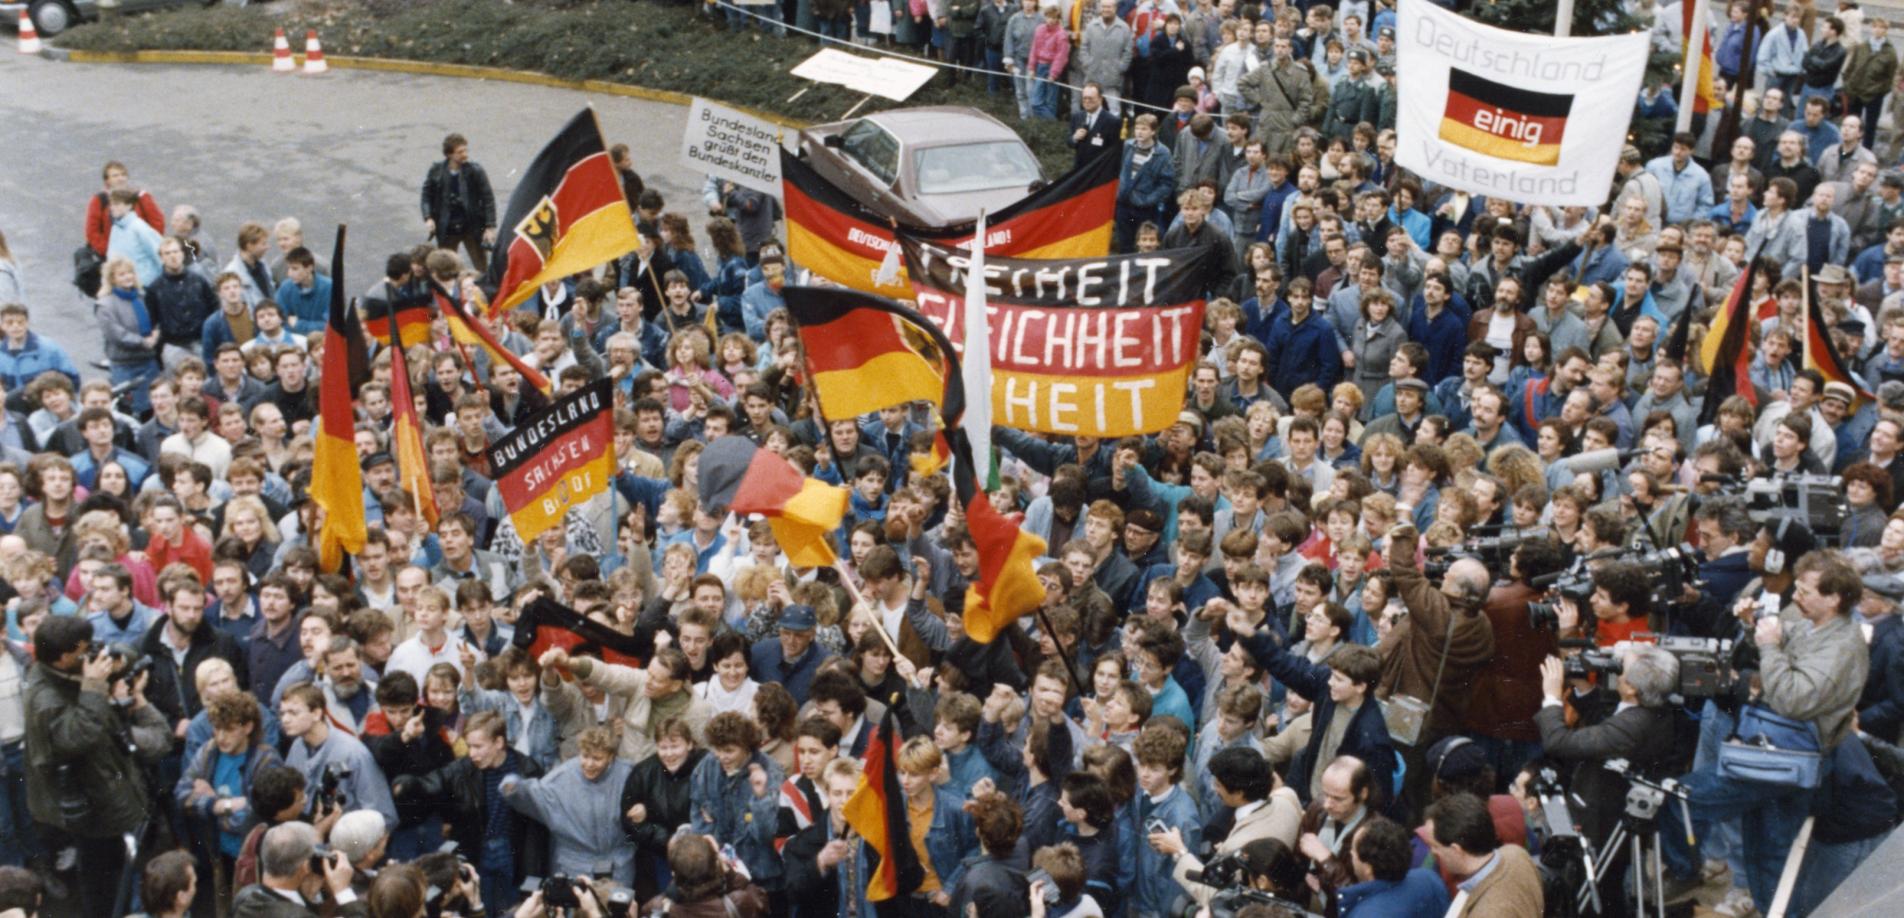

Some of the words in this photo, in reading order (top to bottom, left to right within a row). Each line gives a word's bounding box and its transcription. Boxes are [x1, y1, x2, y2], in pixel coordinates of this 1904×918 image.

[1416, 16, 1607, 82] Deutschland
[706, 125, 770, 155] Sachsen
[1474, 108, 1543, 147] einig
[688, 145, 777, 183] Bundeskanzler
[704, 140, 740, 157] grüßt
[742, 151, 768, 167] den
[1423, 140, 1579, 195] Vaterland
[493, 391, 600, 467] BUNDESLAND
